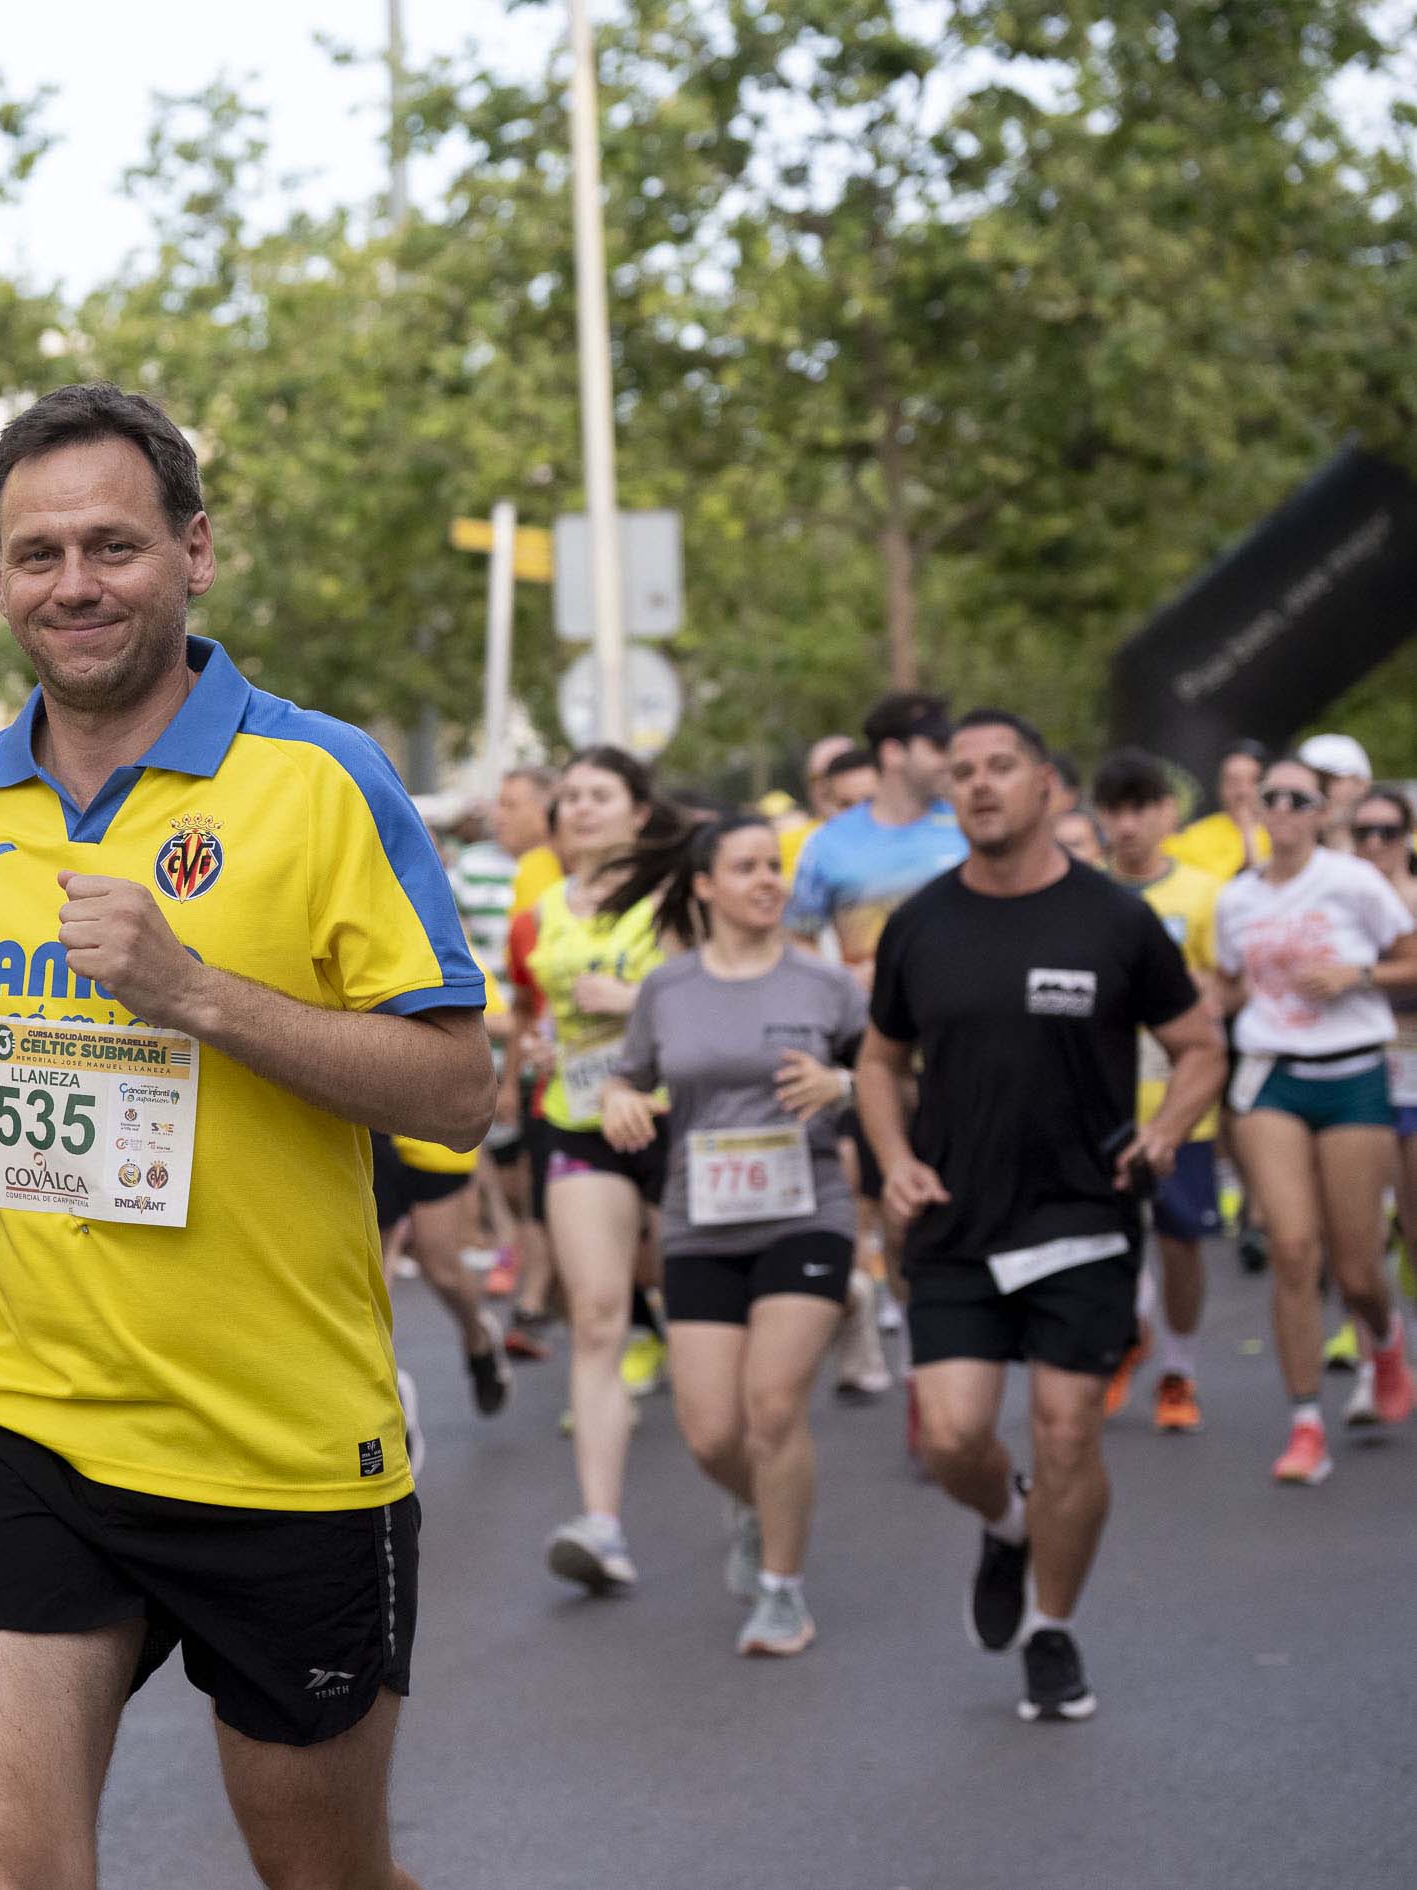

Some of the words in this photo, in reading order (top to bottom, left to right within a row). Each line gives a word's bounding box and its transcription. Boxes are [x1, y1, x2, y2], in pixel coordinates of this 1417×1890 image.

[28, 1030, 54, 1040] CURSA
[54, 1031, 96, 1043] SOLIDÀRIA
[116, 1038, 158, 1048] PARELLES
[20, 1038, 77, 1057] CELTIC
[81, 1044, 167, 1065] SUBMARÍ
[16, 1055, 57, 1065] MEMORIAL
[87, 1062, 123, 1071] MANUEL
[128, 1065, 172, 1075] LLANEZA
[11, 1067, 80, 1089] LLANEZA
[5, 1166, 88, 1194] COVALCA
[6, 1193, 40, 1202] COMERCIAL
[43, 1195, 51, 1203] DE
[114, 1195, 167, 1214] ENDAVANT
[315, 1685, 349, 1699] TENTH
